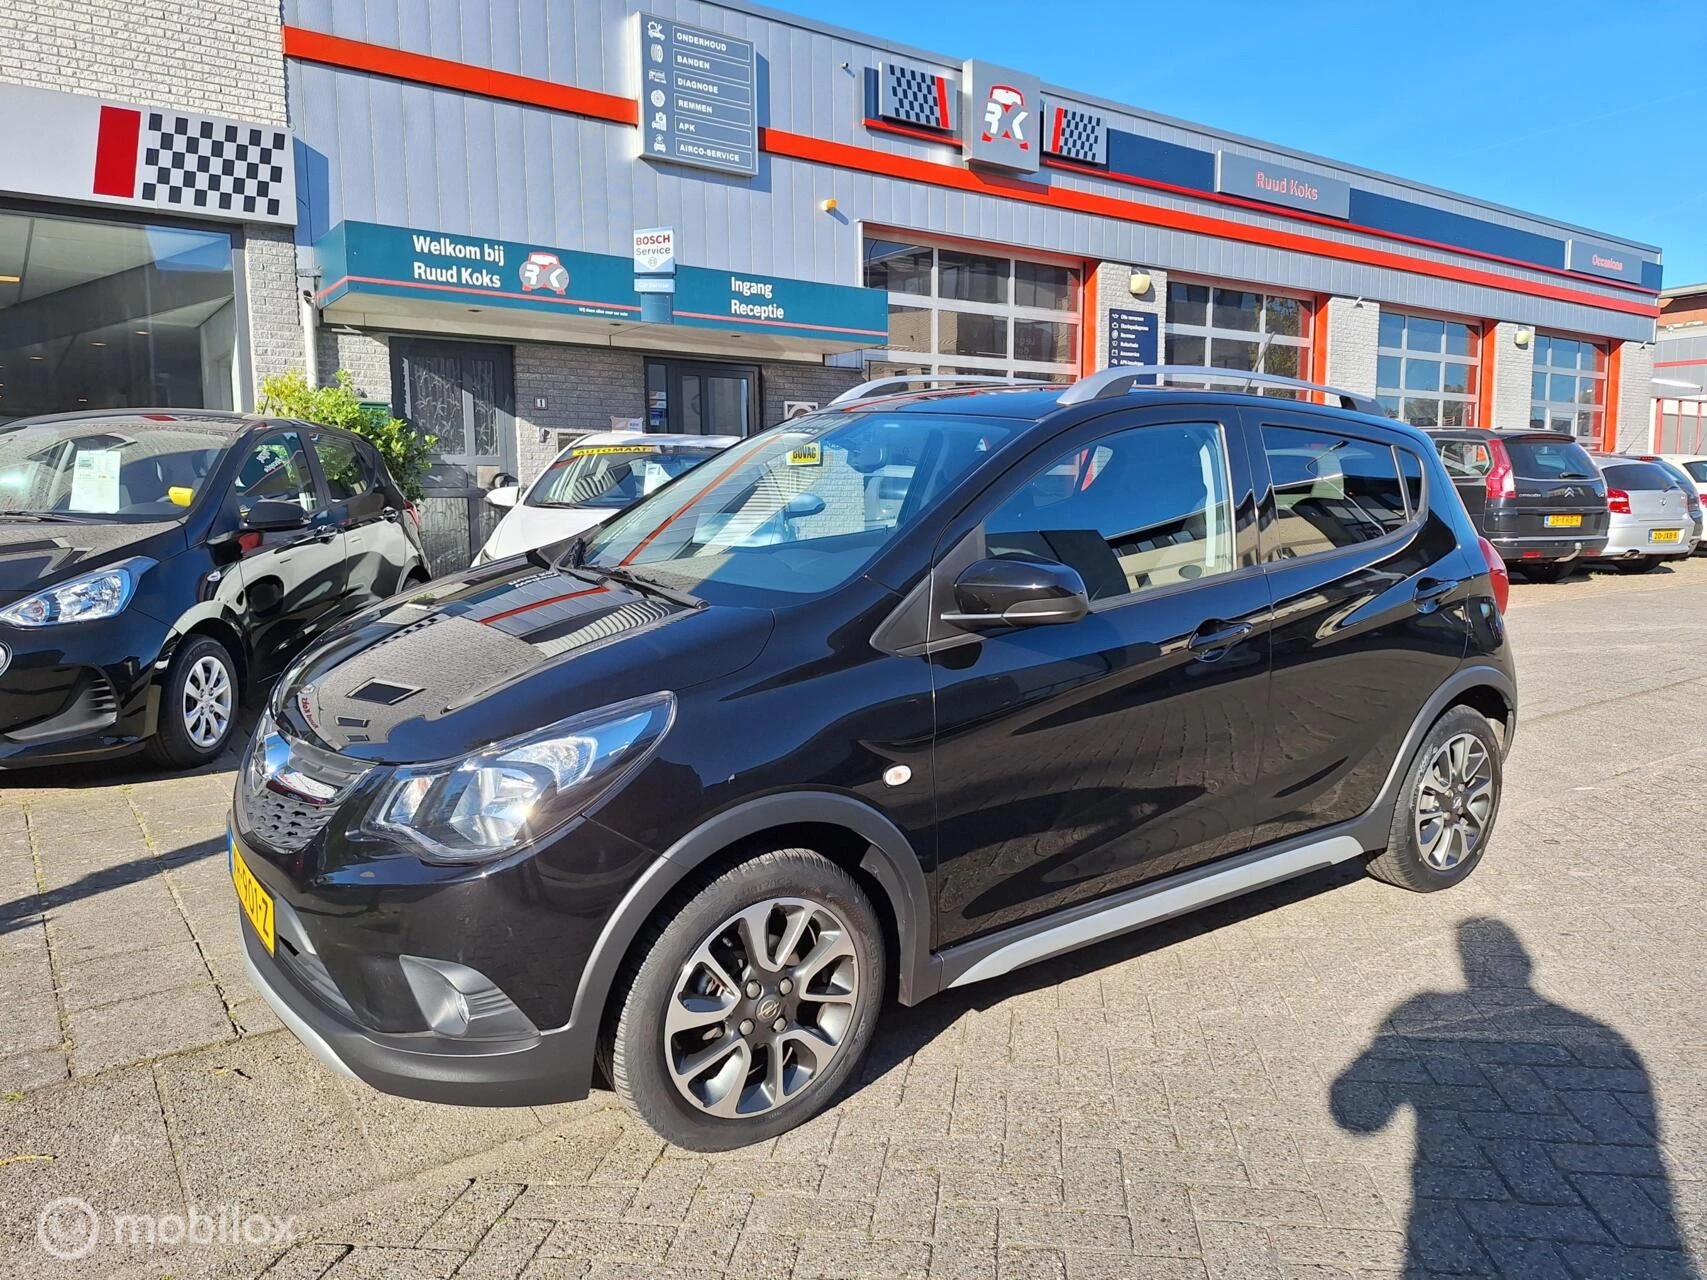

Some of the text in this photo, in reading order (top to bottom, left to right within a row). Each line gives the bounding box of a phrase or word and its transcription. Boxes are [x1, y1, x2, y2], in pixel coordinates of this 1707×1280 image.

[676, 32, 727, 52] ONDERHOUD
[676, 55, 710, 70] BANDEN
[677, 77, 719, 94] DIAGNOSE
[678, 99, 713, 114] REMMEN
[678, 121, 696, 133] APK
[679, 143, 740, 162] AIRCO-SERVICE
[1256, 170, 1318, 200] Ruud Koks
[635, 234, 671, 246] BOSCH
[412, 234, 505, 266] Welkom bij
[635, 246, 671, 256] Service
[413, 261, 501, 288] Ruud Koks
[731, 276, 773, 299] Ingang
[731, 299, 785, 320] Receptie
